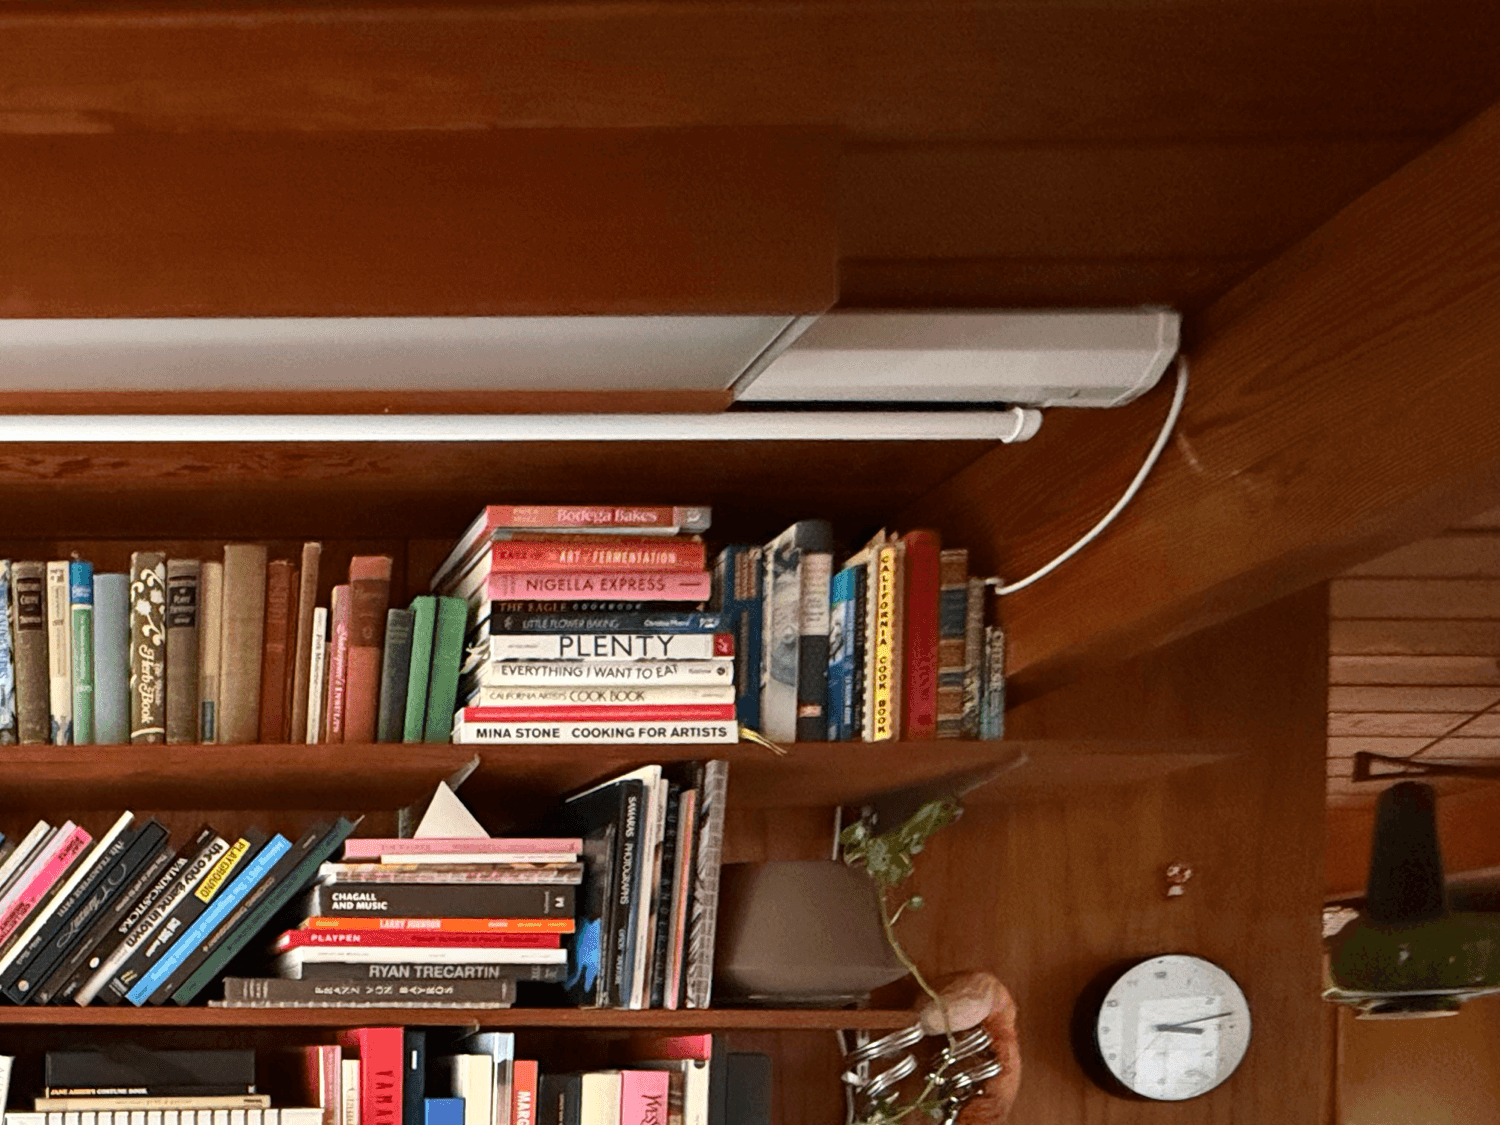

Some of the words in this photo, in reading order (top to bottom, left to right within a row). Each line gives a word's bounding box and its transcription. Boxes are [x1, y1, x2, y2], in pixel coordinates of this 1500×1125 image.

[557, 509, 612, 523] Bodega
[615, 508, 657, 522] Bakes
[526, 578, 594, 592] NIGELLA
[599, 577, 665, 591] EXPRESS
[879, 554, 890, 646] CALIFORNIA
[559, 635, 675, 657] PLENTY
[138, 644, 155, 683] Herb
[501, 664, 583, 678] EVERYTHING
[594, 666, 633, 679] WANT
[635, 666, 653, 679] TO
[656, 664, 678, 679] EAT
[878, 655, 888, 690] COOK
[139, 683, 155, 724] Book
[569, 690, 607, 703] COOK
[610, 690, 645, 702] BOOK
[876, 699, 887, 733] BOOK
[476, 727, 512, 739] MINA
[515, 727, 560, 739] STONE
[571, 727, 634, 739] COOKING
[639, 727, 668, 738] FOR
[670, 727, 727, 738] ARTISTS
[203, 841, 225, 864] the
[181, 857, 209, 887] only
[194, 840, 251, 899] PLAYGROUND
[155, 880, 189, 915] game
[332, 892, 377, 901] CHAGALL
[332, 902, 354, 910] AND
[356, 902, 388, 911] MUSIC
[125, 918, 155, 950] town
[310, 934, 361, 942] PLAYPEN
[369, 965, 410, 978] RYAN
[412, 965, 500, 979] TRECARTIN
